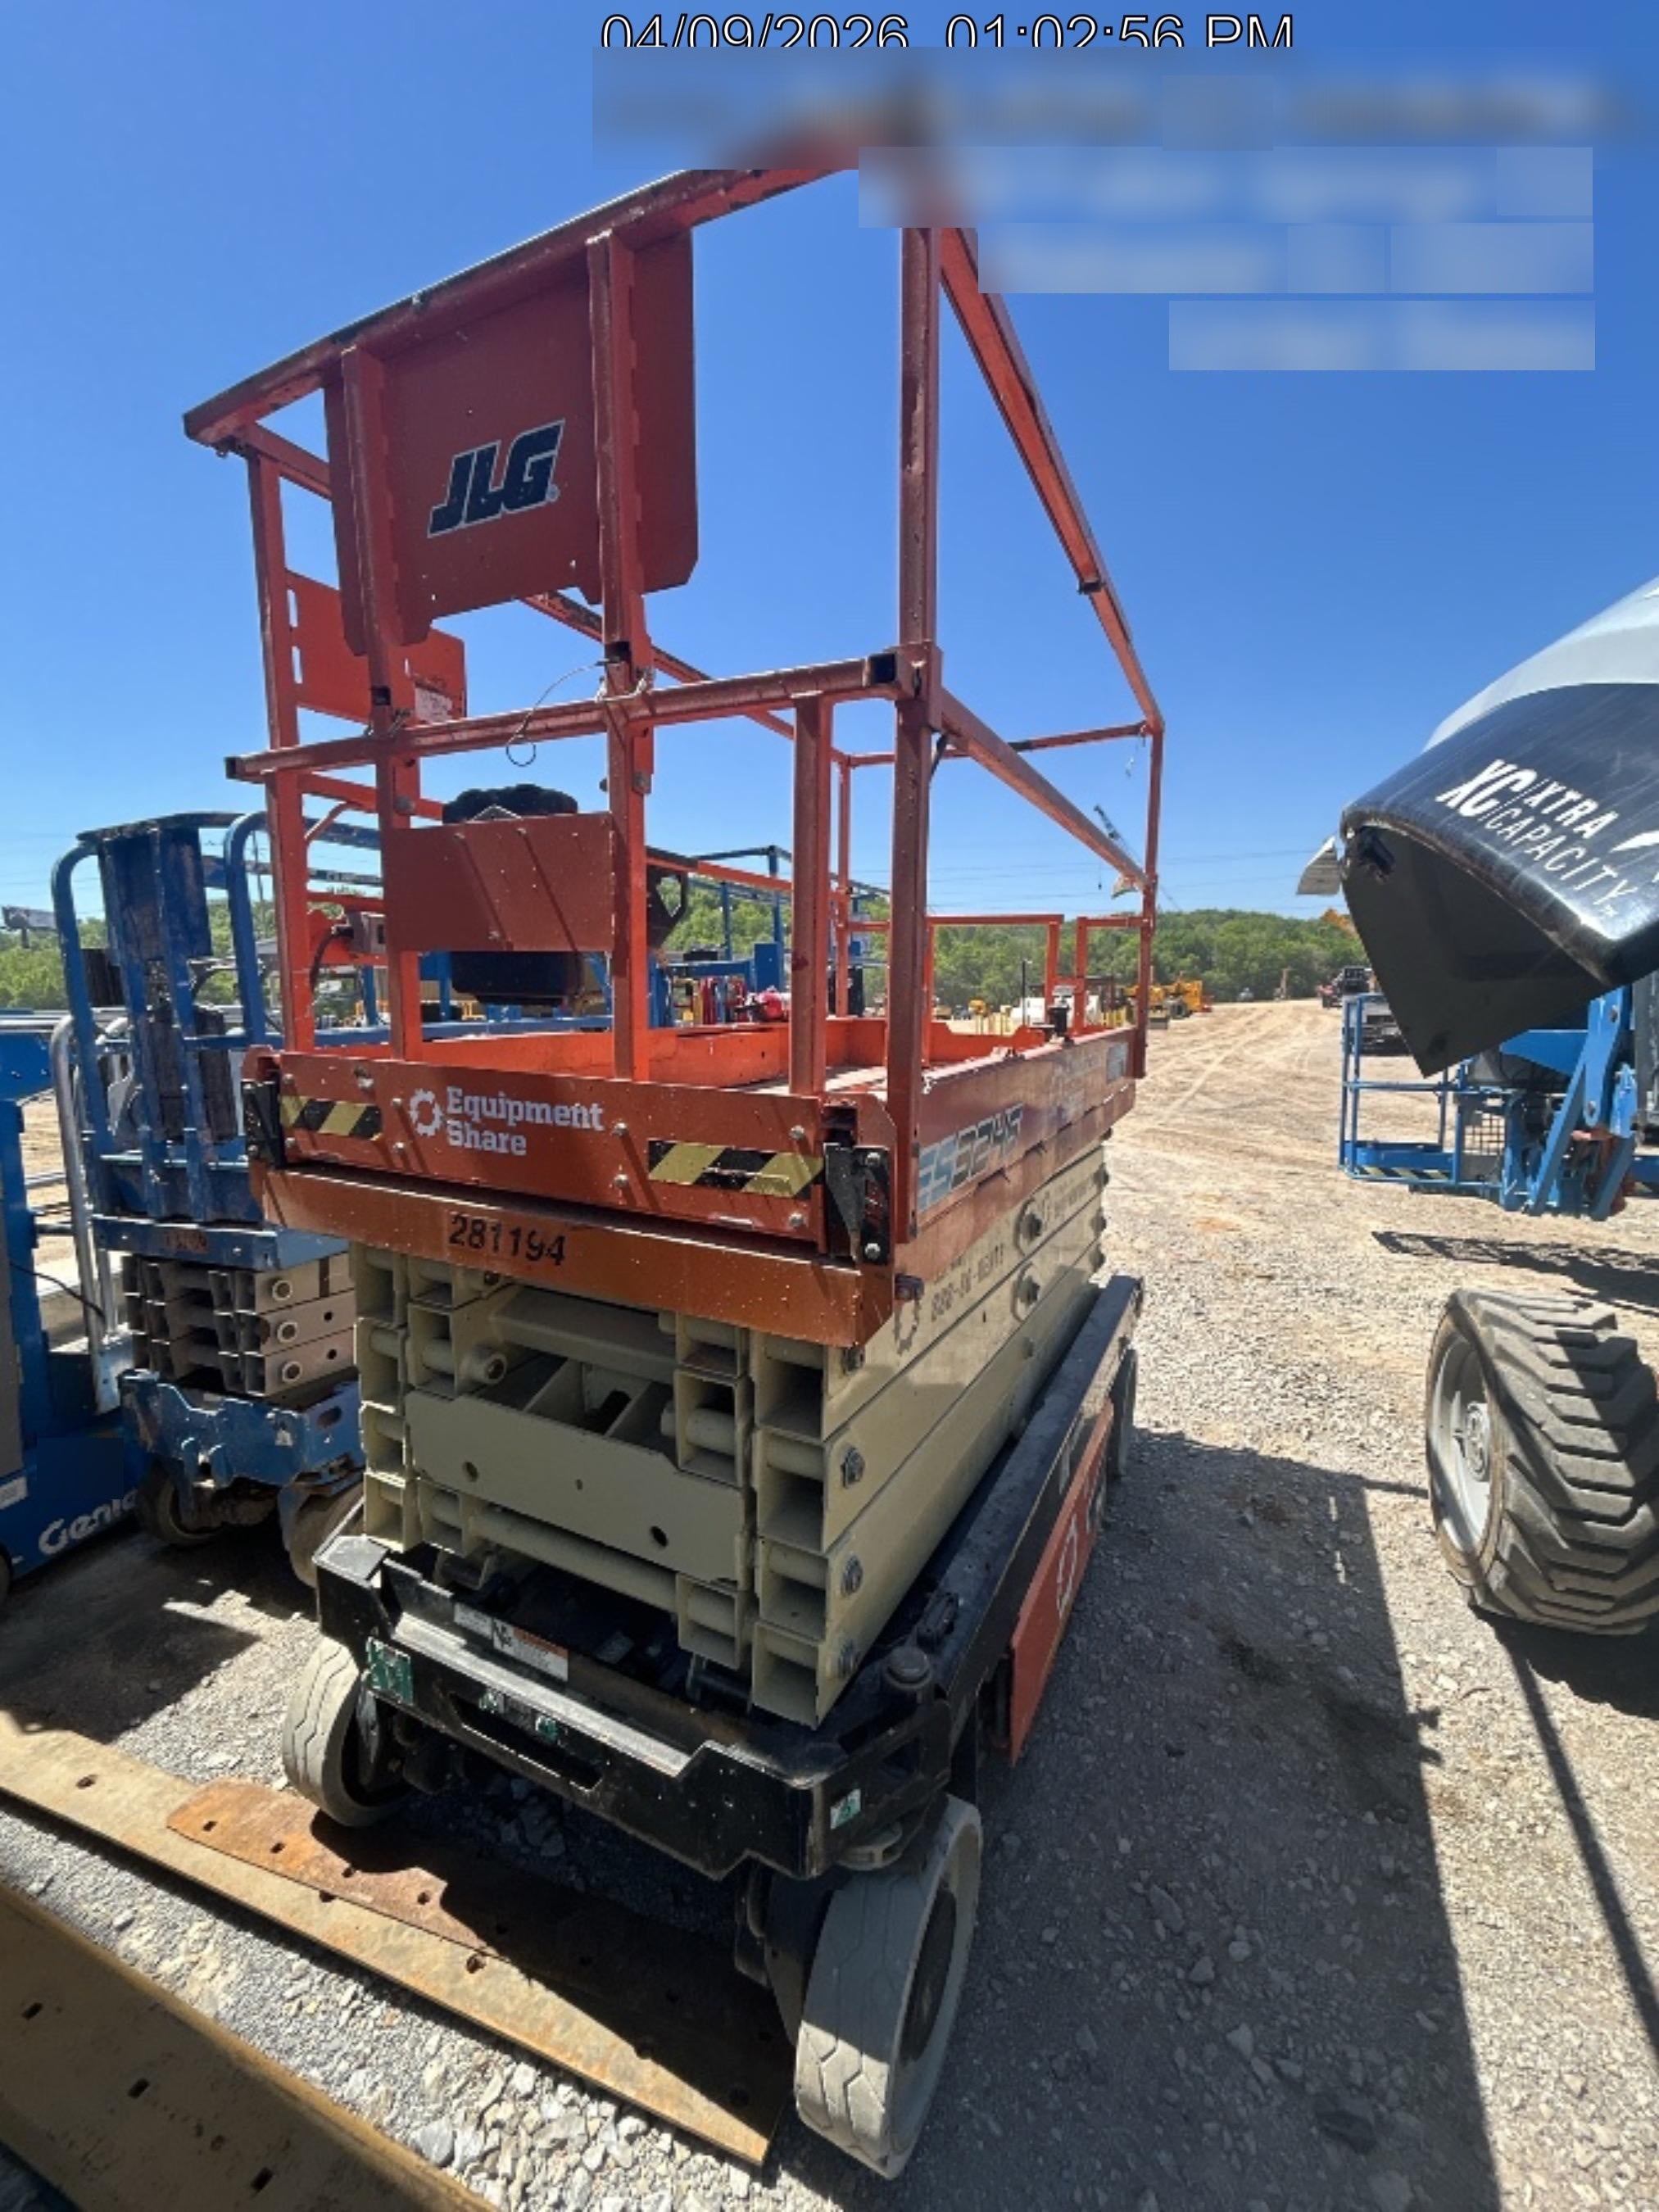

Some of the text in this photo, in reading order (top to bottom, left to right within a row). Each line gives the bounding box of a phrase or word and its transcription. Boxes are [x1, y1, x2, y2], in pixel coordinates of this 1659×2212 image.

[427, 418, 565, 538] JLG
[1435, 759, 1537, 817] XC
[1524, 781, 1619, 839] XTRA
[1485, 808, 1639, 905] CAPACITY
[446, 1086, 605, 1131] Equipment
[446, 1120, 527, 1156] Share
[449, 1213, 566, 1266] 281194
